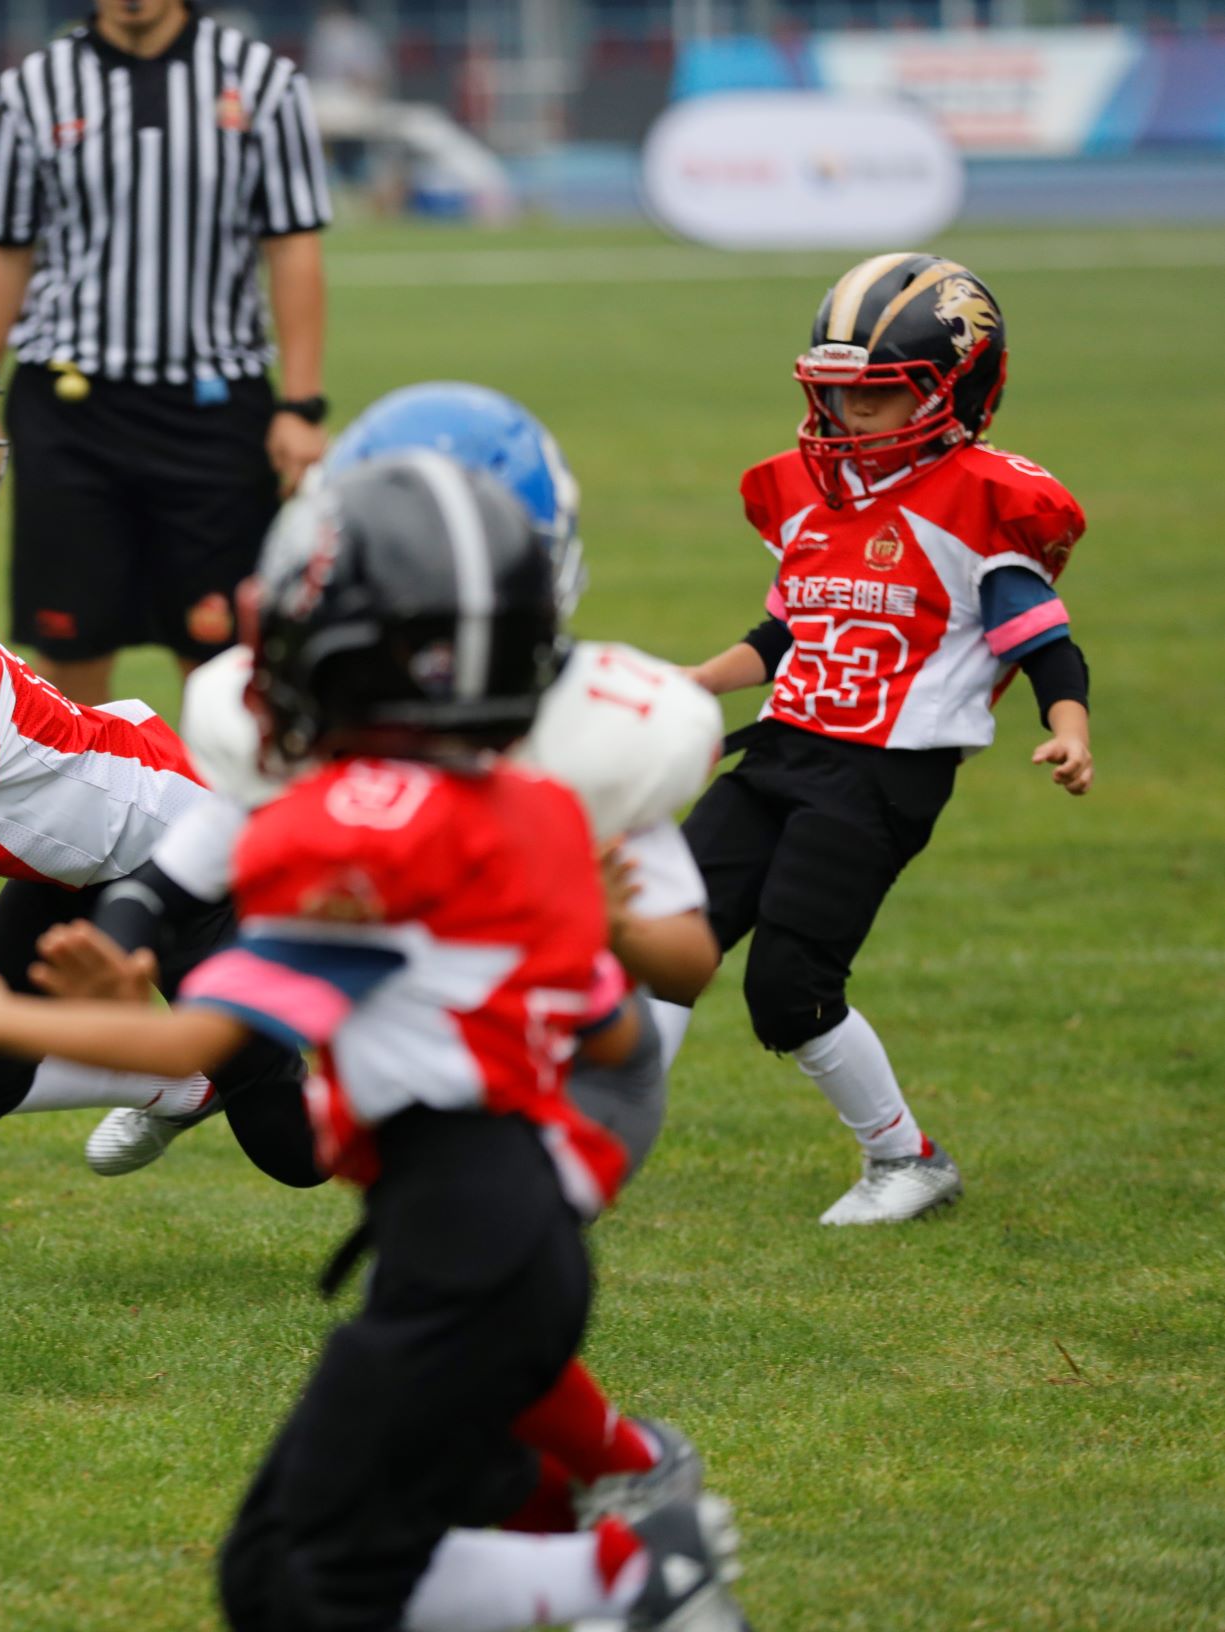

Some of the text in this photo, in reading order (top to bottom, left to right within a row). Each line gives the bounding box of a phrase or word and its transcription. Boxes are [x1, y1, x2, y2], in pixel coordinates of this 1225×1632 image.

[784, 575, 918, 618] 北区全明星
[775, 615, 909, 733] 53
